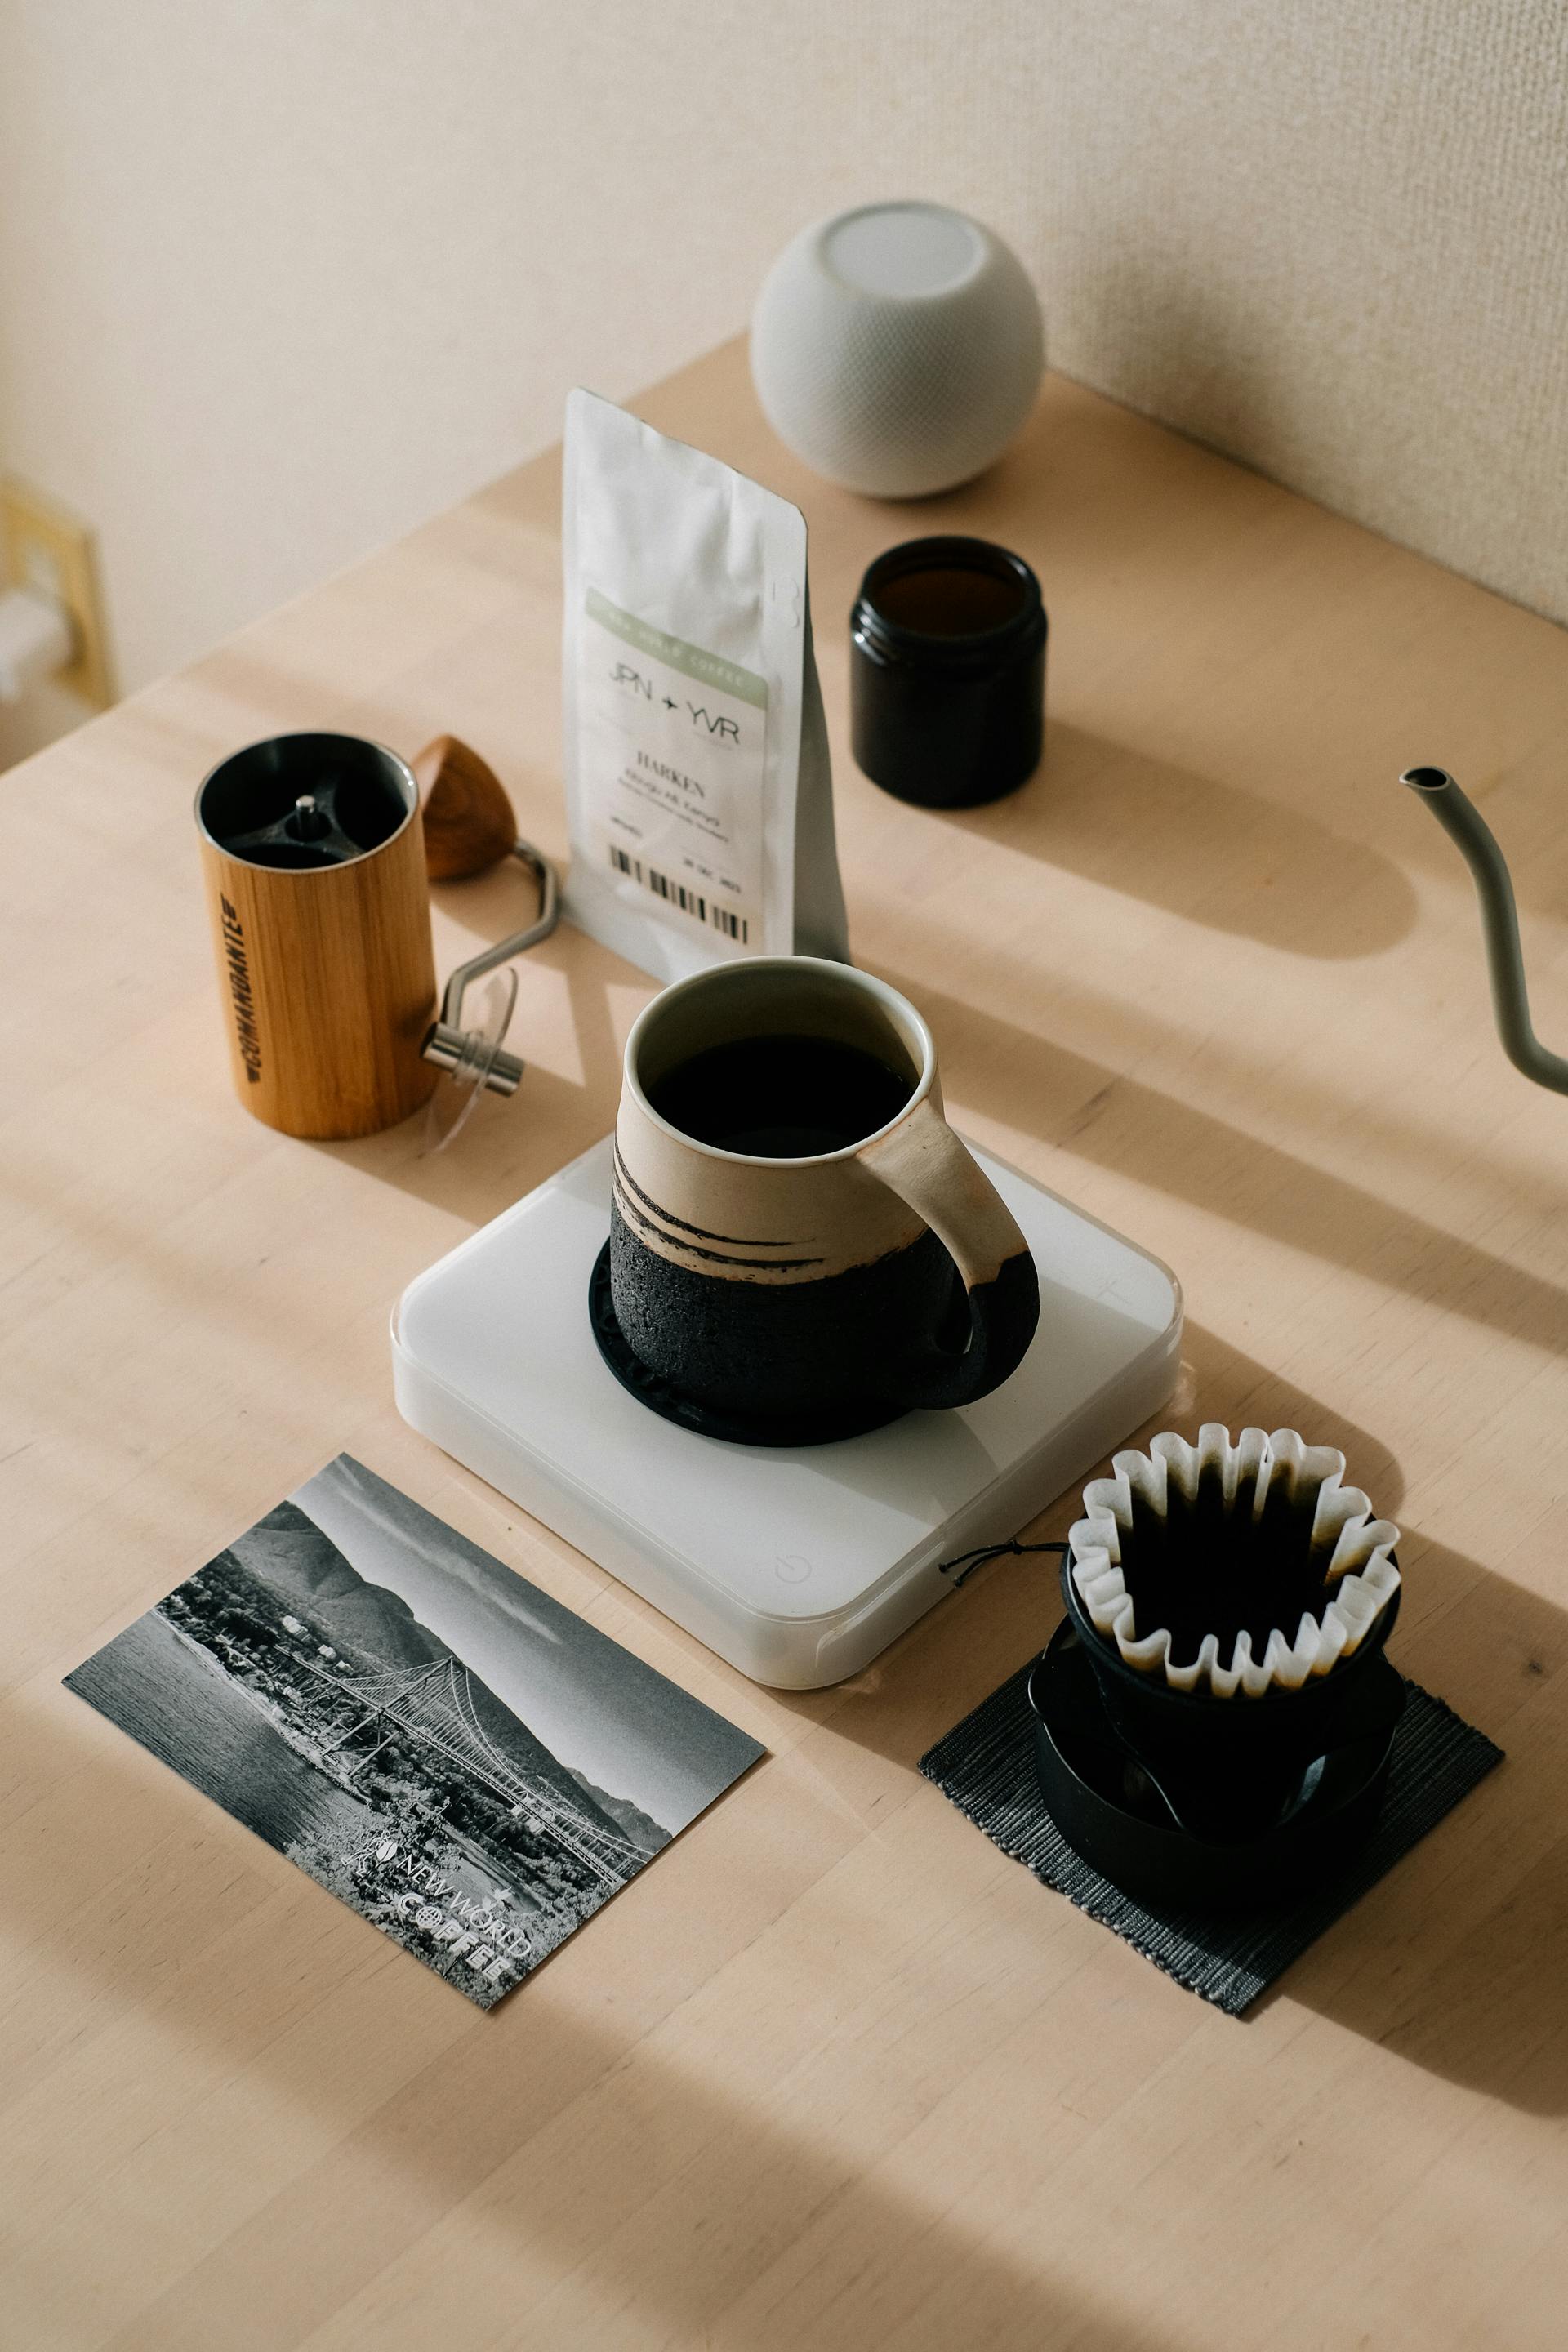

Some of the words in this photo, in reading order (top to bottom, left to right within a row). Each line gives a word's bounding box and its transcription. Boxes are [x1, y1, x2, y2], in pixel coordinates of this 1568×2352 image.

[608, 662, 653, 701] JPN
[686, 701, 741, 745] YVR
[221, 913, 262, 1068] COMANDANTE
[396, 1854, 455, 1897] NEW
[448, 1891, 532, 1958] WORLD
[396, 1892, 511, 1982] COFFEE
